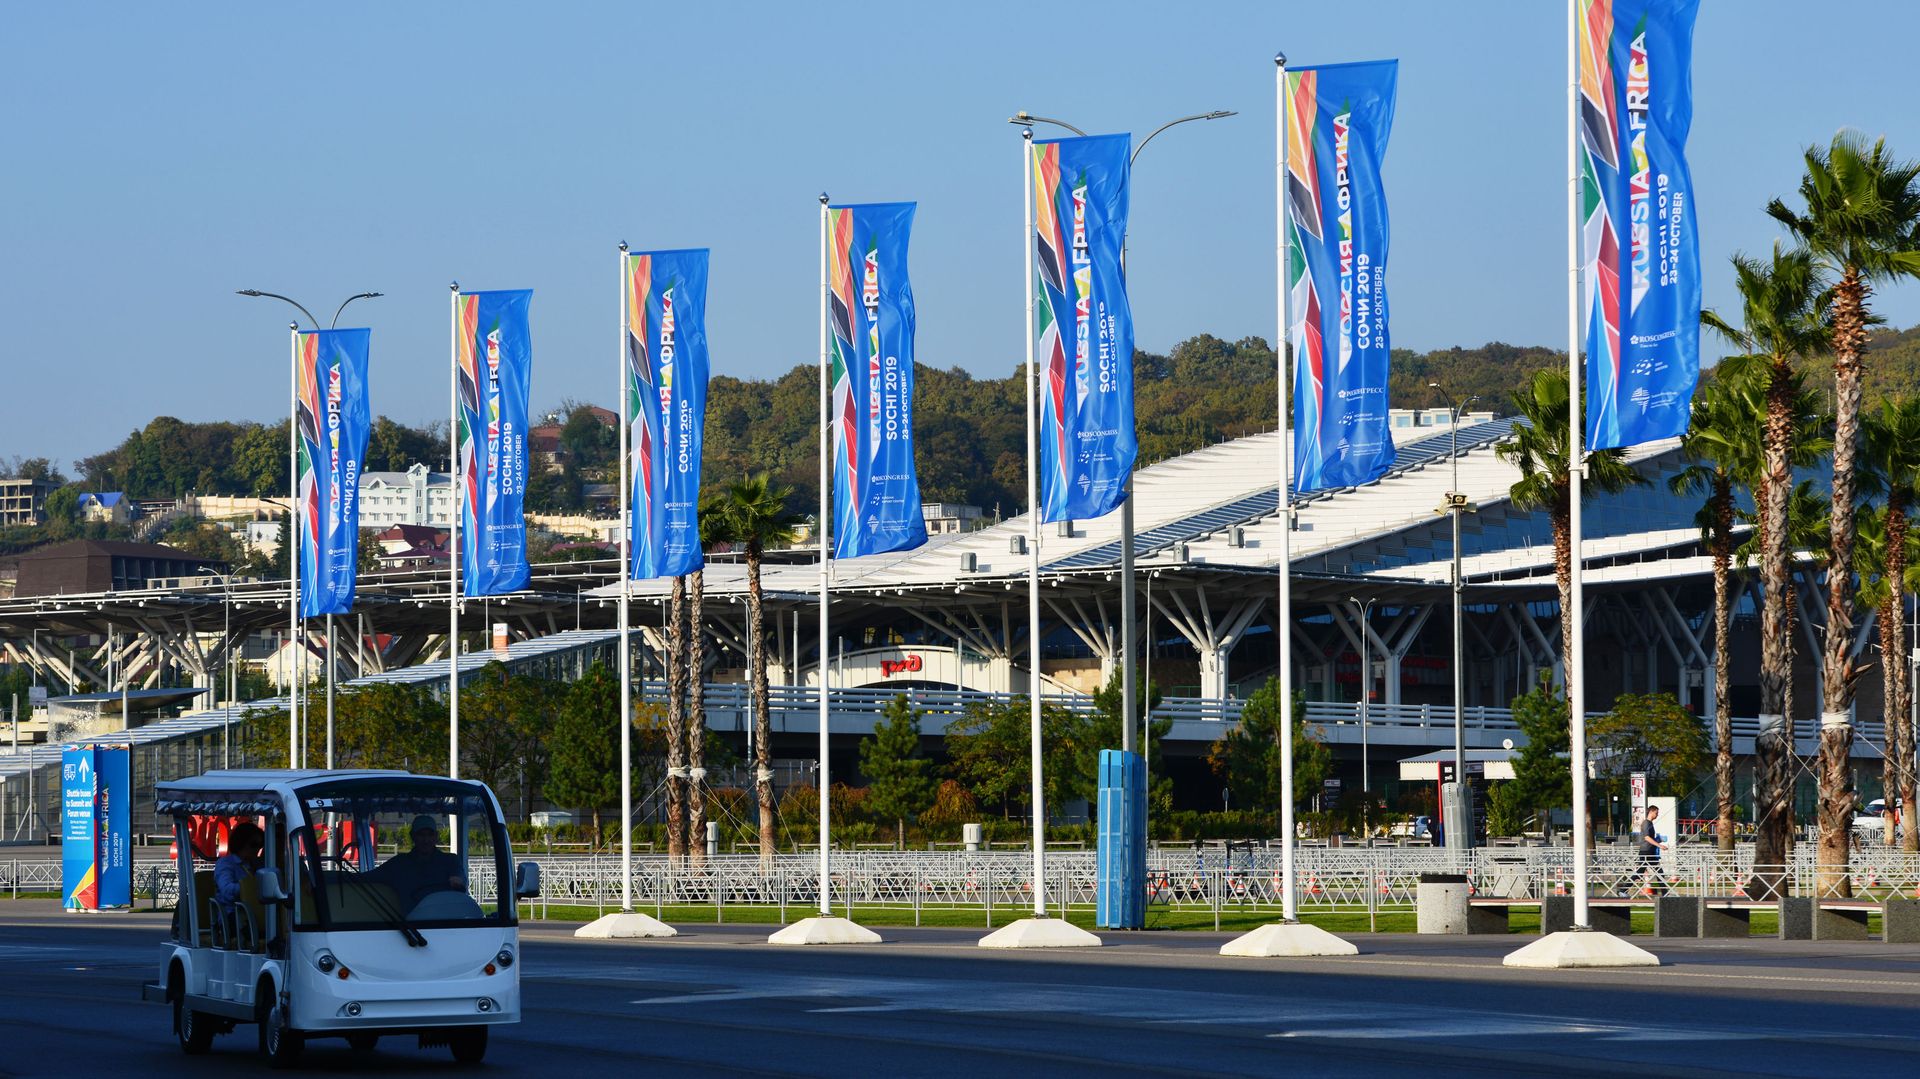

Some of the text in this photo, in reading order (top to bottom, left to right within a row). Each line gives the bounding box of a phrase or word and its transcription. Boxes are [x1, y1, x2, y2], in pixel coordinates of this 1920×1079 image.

[1658, 174, 1669, 287] SOCHI 2019
[1670, 192, 1684, 246] OCTOBER
[1357, 254, 1370, 349] СОЧИ 2019
[1375, 267, 1383, 315] ОКТЯБРЯ
[1099, 302, 1110, 393] SOCHI 2019
[1108, 315, 1116, 361] OCTOBER
[886, 357, 897, 440] SOCHI 2019
[346, 460, 356, 487] 2019
[503, 422, 512, 495] SOCHI 2019
[679, 434, 688, 473] СОЧИ
[316, 799, 325, 807] 9
